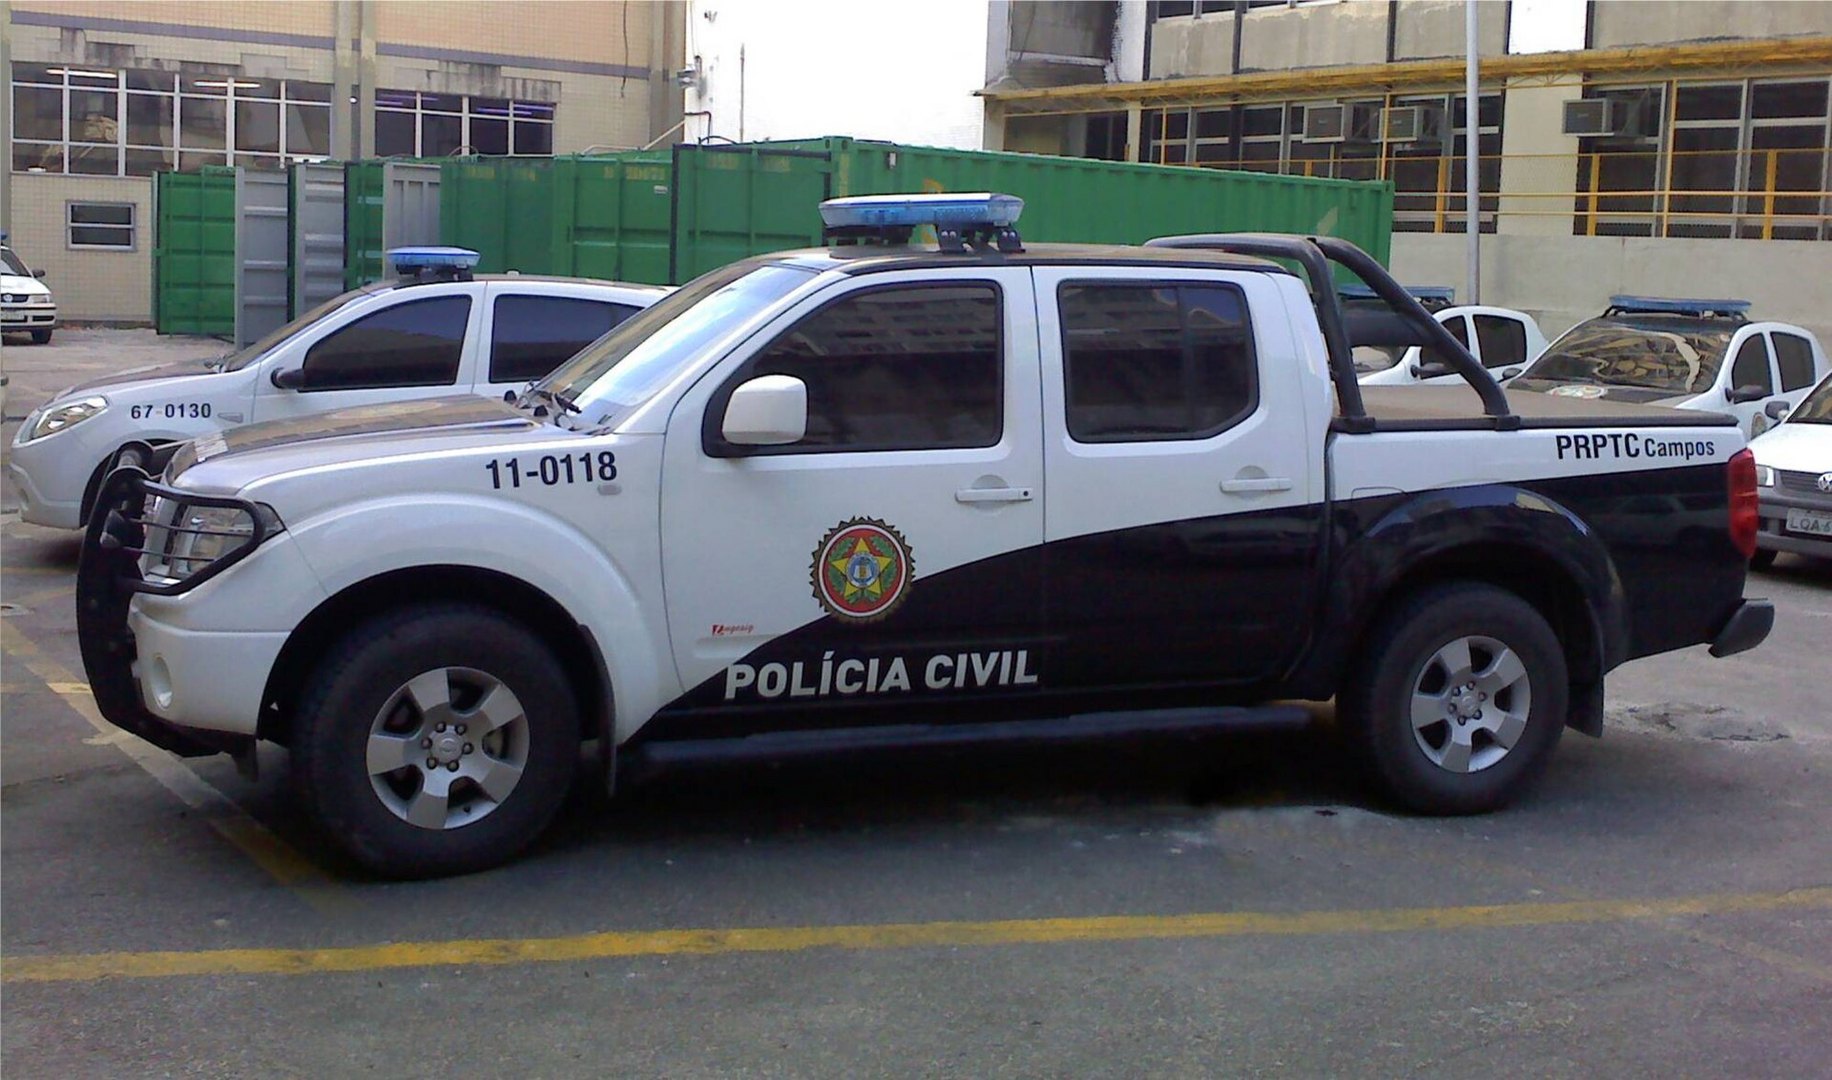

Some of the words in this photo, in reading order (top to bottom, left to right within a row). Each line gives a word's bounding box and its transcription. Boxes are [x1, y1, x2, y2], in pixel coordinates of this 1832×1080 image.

[131, 403, 211, 419] 67-0130
[1555, 433, 1640, 459] PRPTC
[1644, 438, 1715, 460] Campos
[485, 451, 617, 489] 11-0118
[724, 650, 911, 699] POLÍCIA
[924, 650, 1038, 689] CIVIL
